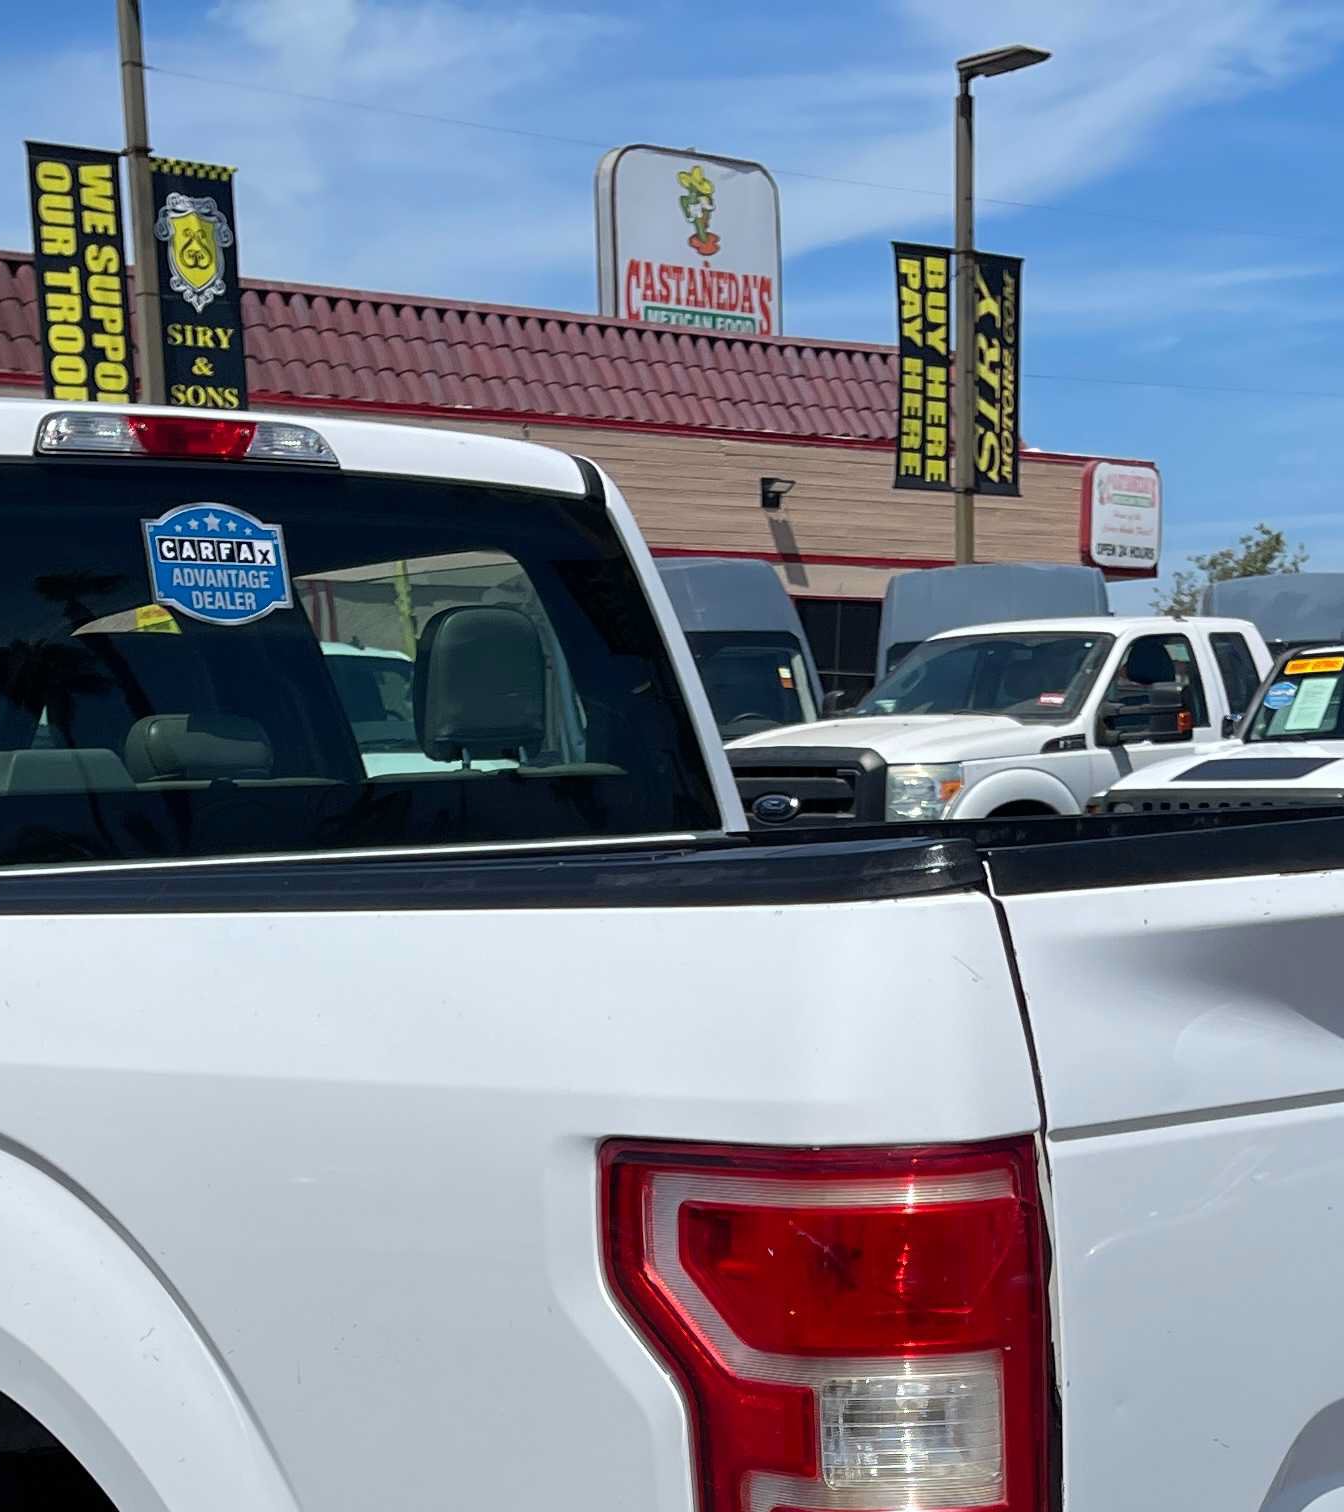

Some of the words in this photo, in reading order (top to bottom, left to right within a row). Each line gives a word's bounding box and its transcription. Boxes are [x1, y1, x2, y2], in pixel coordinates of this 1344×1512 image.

[35, 161, 78, 256] OUR
[77, 163, 118, 237] WE
[166, 323, 234, 350] SIRY
[898, 258, 923, 347] PAY
[924, 255, 948, 354] BUY
[170, 383, 240, 410] SONS
[191, 356, 215, 377] &
[975, 264, 1001, 484] SIRY
[899, 356, 923, 477] HERE
[925, 364, 948, 482] HERE
[159, 539, 275, 565] CARFAX
[172, 567, 271, 590] ADVANTAGE
[191, 590, 257, 611] DEALER
